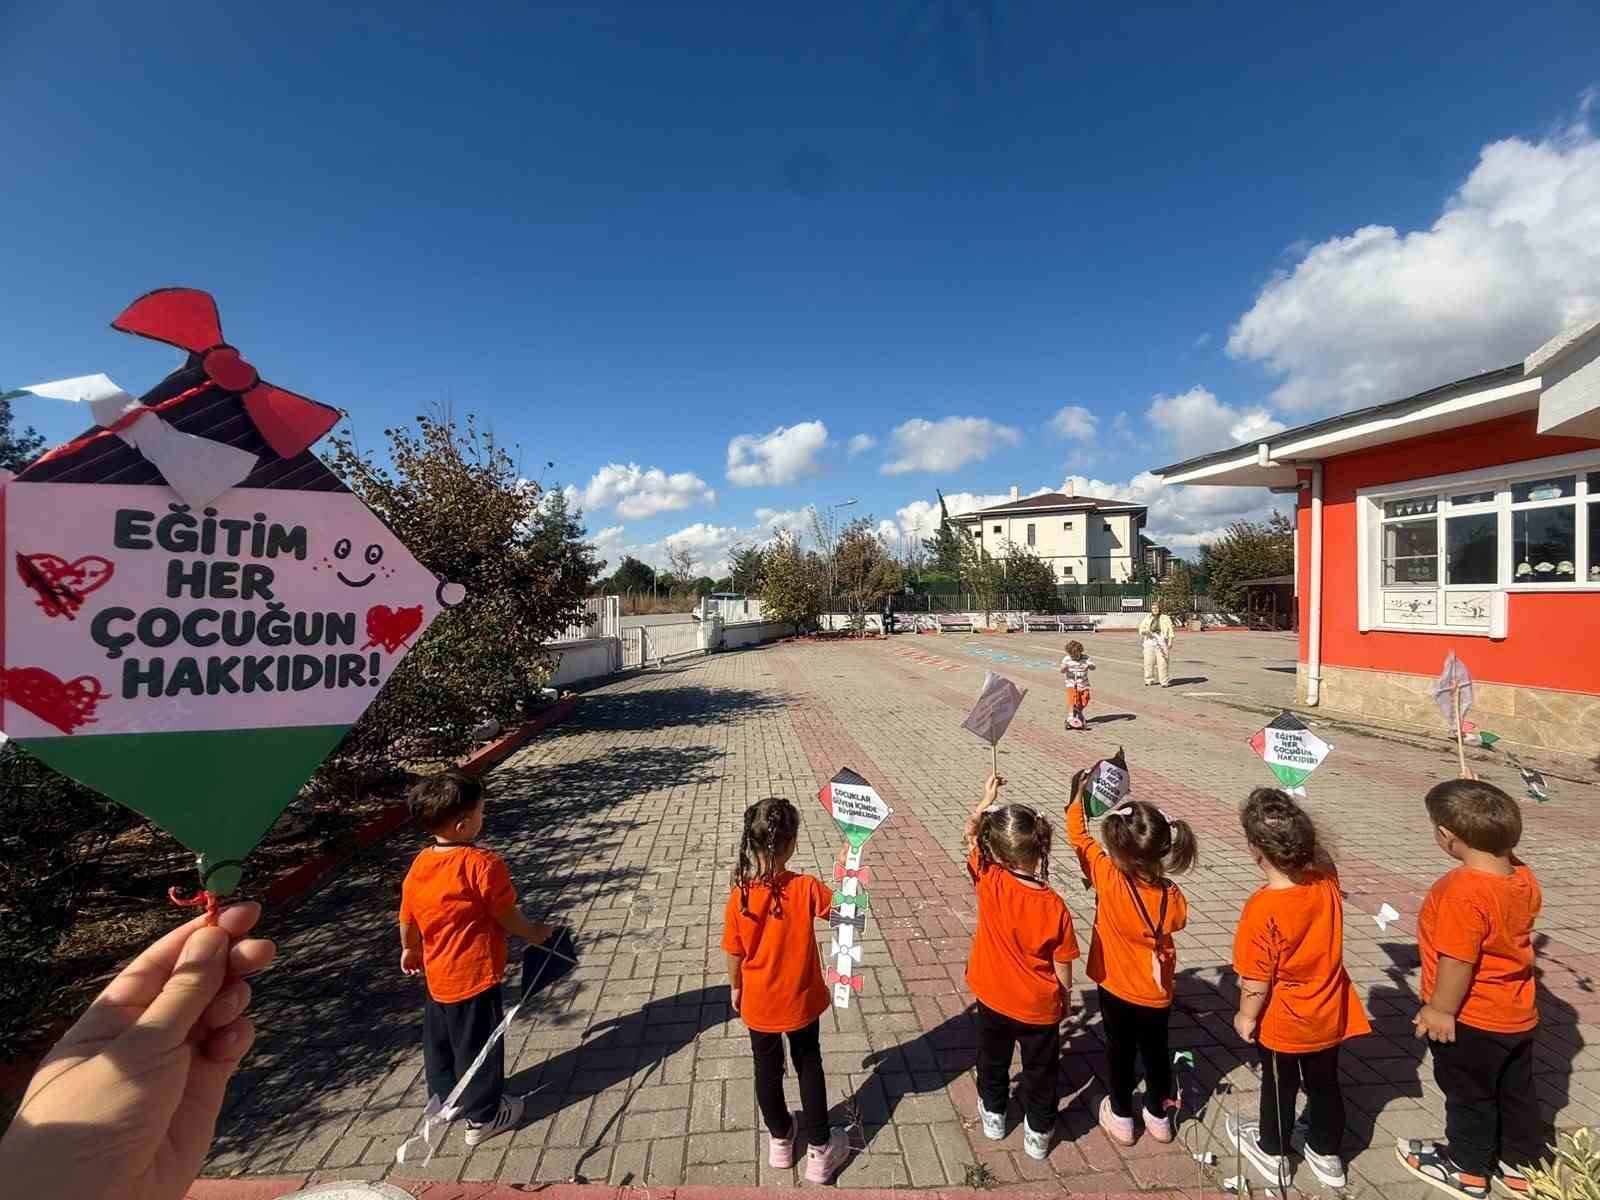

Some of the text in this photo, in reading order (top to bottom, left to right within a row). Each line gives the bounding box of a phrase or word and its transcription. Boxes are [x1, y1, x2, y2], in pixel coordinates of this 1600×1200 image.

[113, 502, 307, 561] EĞİTİM
[165, 558, 275, 601] HER
[90, 601, 356, 659] ÇOCUĞUN
[121, 651, 381, 700] HAKKIDIR!
